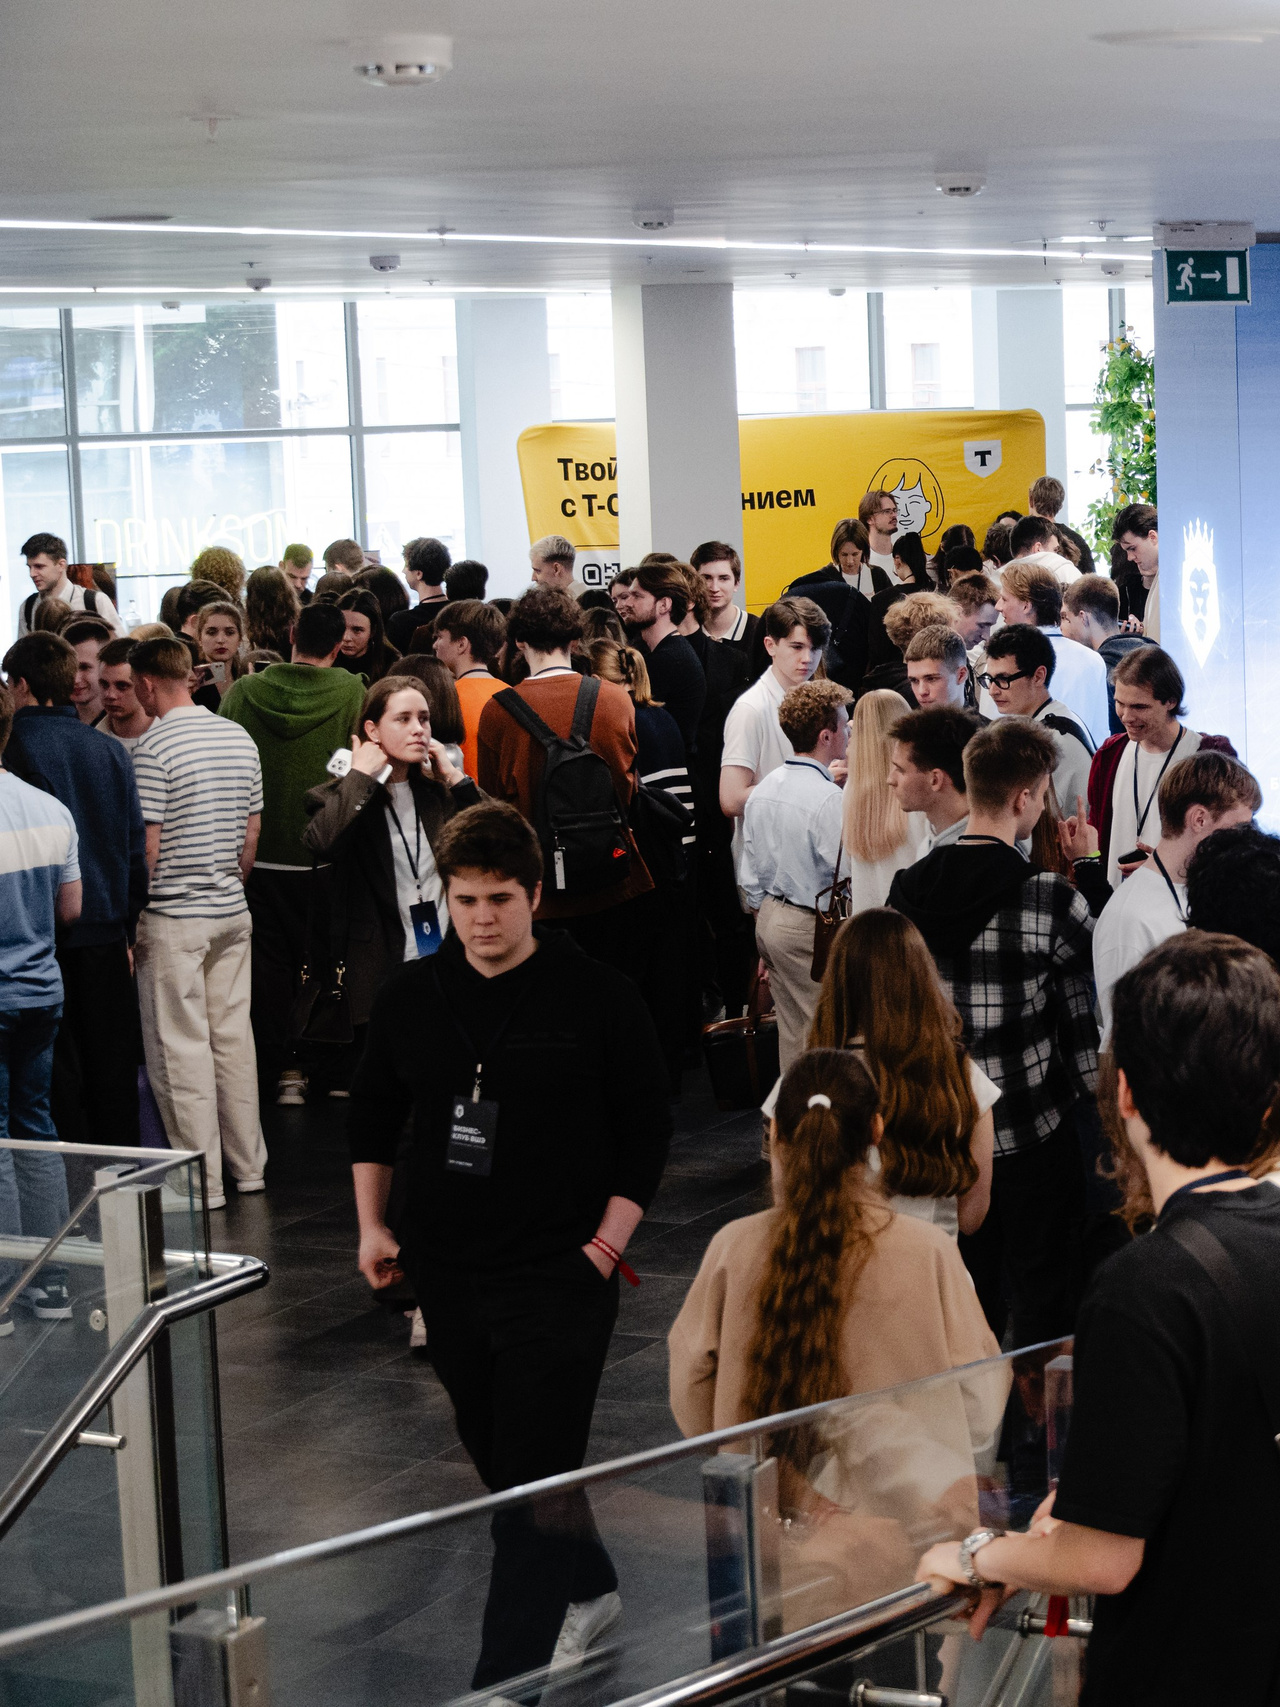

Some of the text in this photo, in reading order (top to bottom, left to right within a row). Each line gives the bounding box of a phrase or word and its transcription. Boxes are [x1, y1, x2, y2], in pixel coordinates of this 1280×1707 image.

[557, 456, 617, 482] Твой
[560, 498, 577, 518] с
[451, 1132, 486, 1144] КЛУБ ВШЭ
[453, 1125, 481, 1135] БИЗНЕС-
